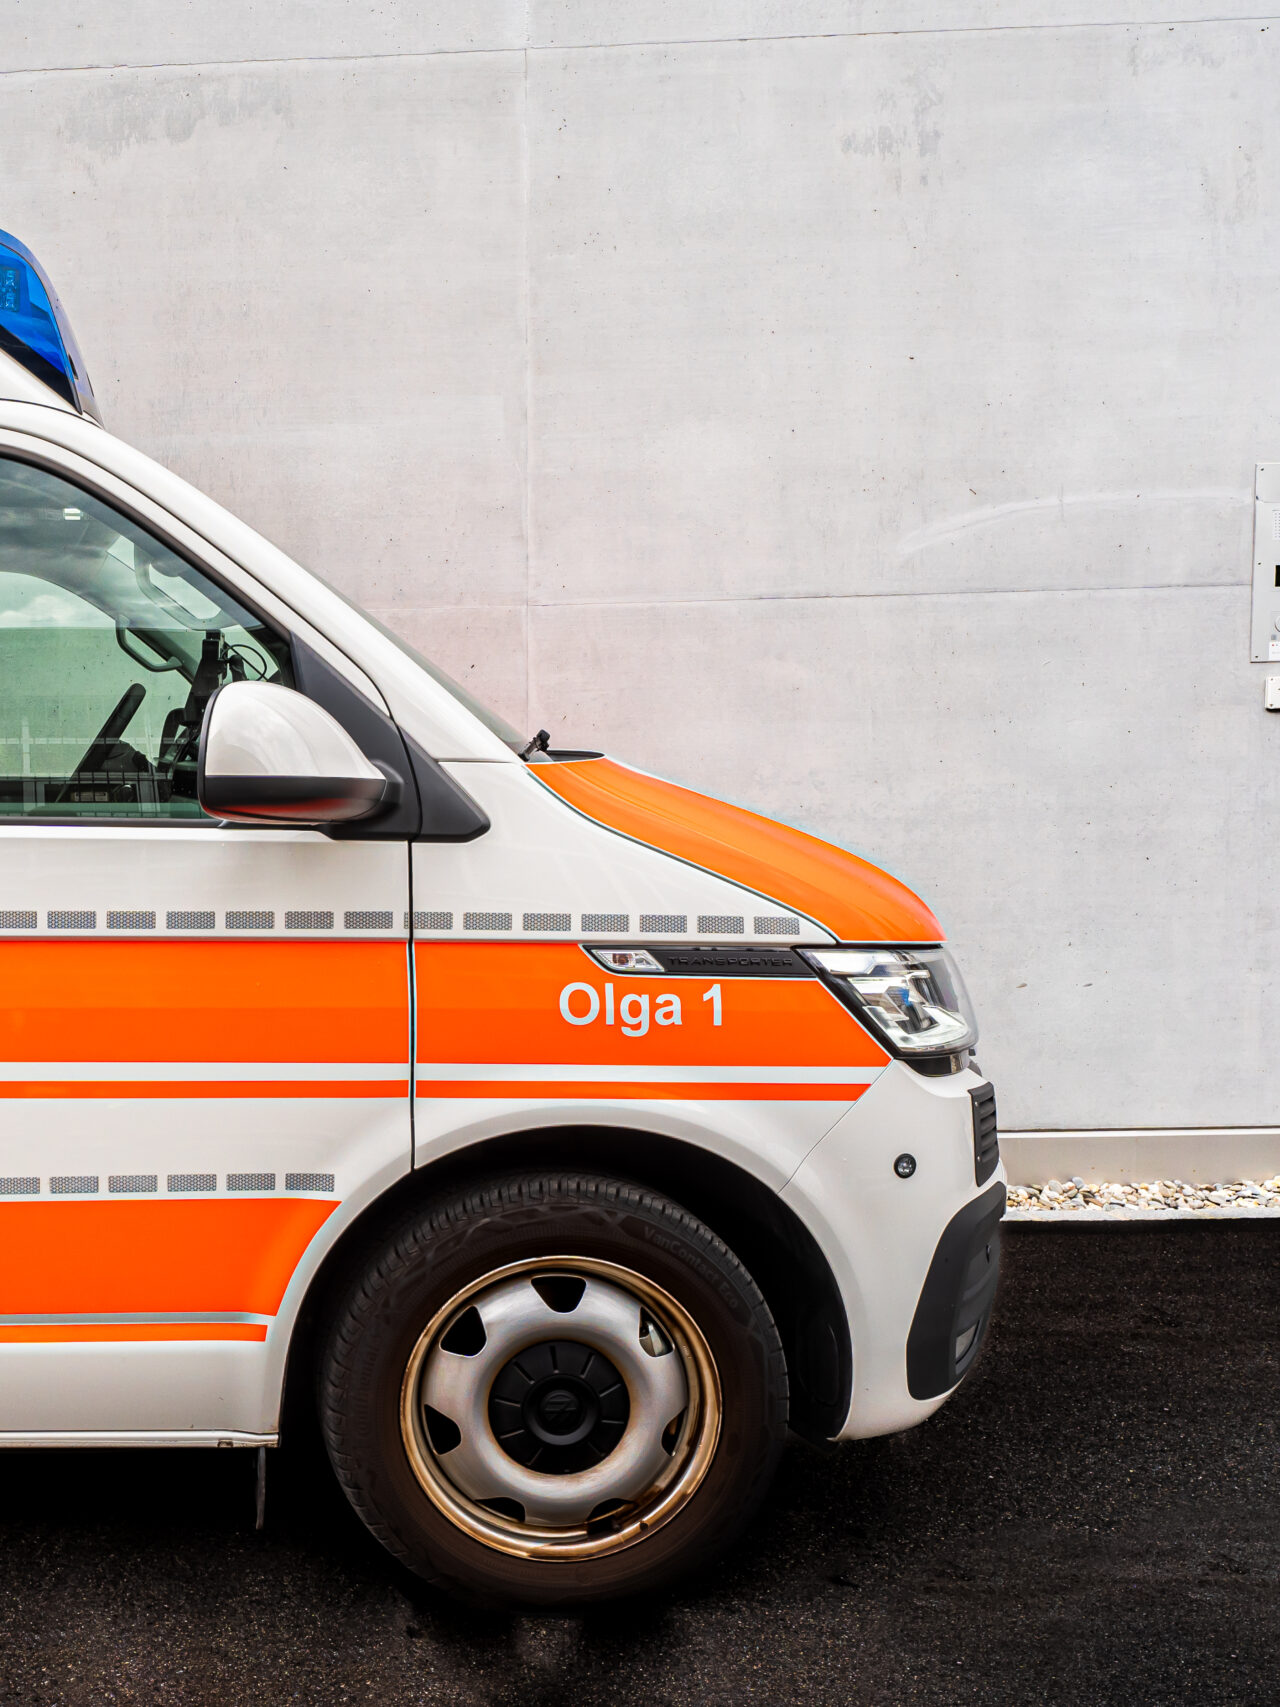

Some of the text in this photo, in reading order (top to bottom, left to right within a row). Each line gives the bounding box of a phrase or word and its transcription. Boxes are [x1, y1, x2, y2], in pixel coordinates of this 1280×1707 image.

[670, 956, 793, 966] TRANSPORTER
[559, 982, 722, 1037] Olga 1
